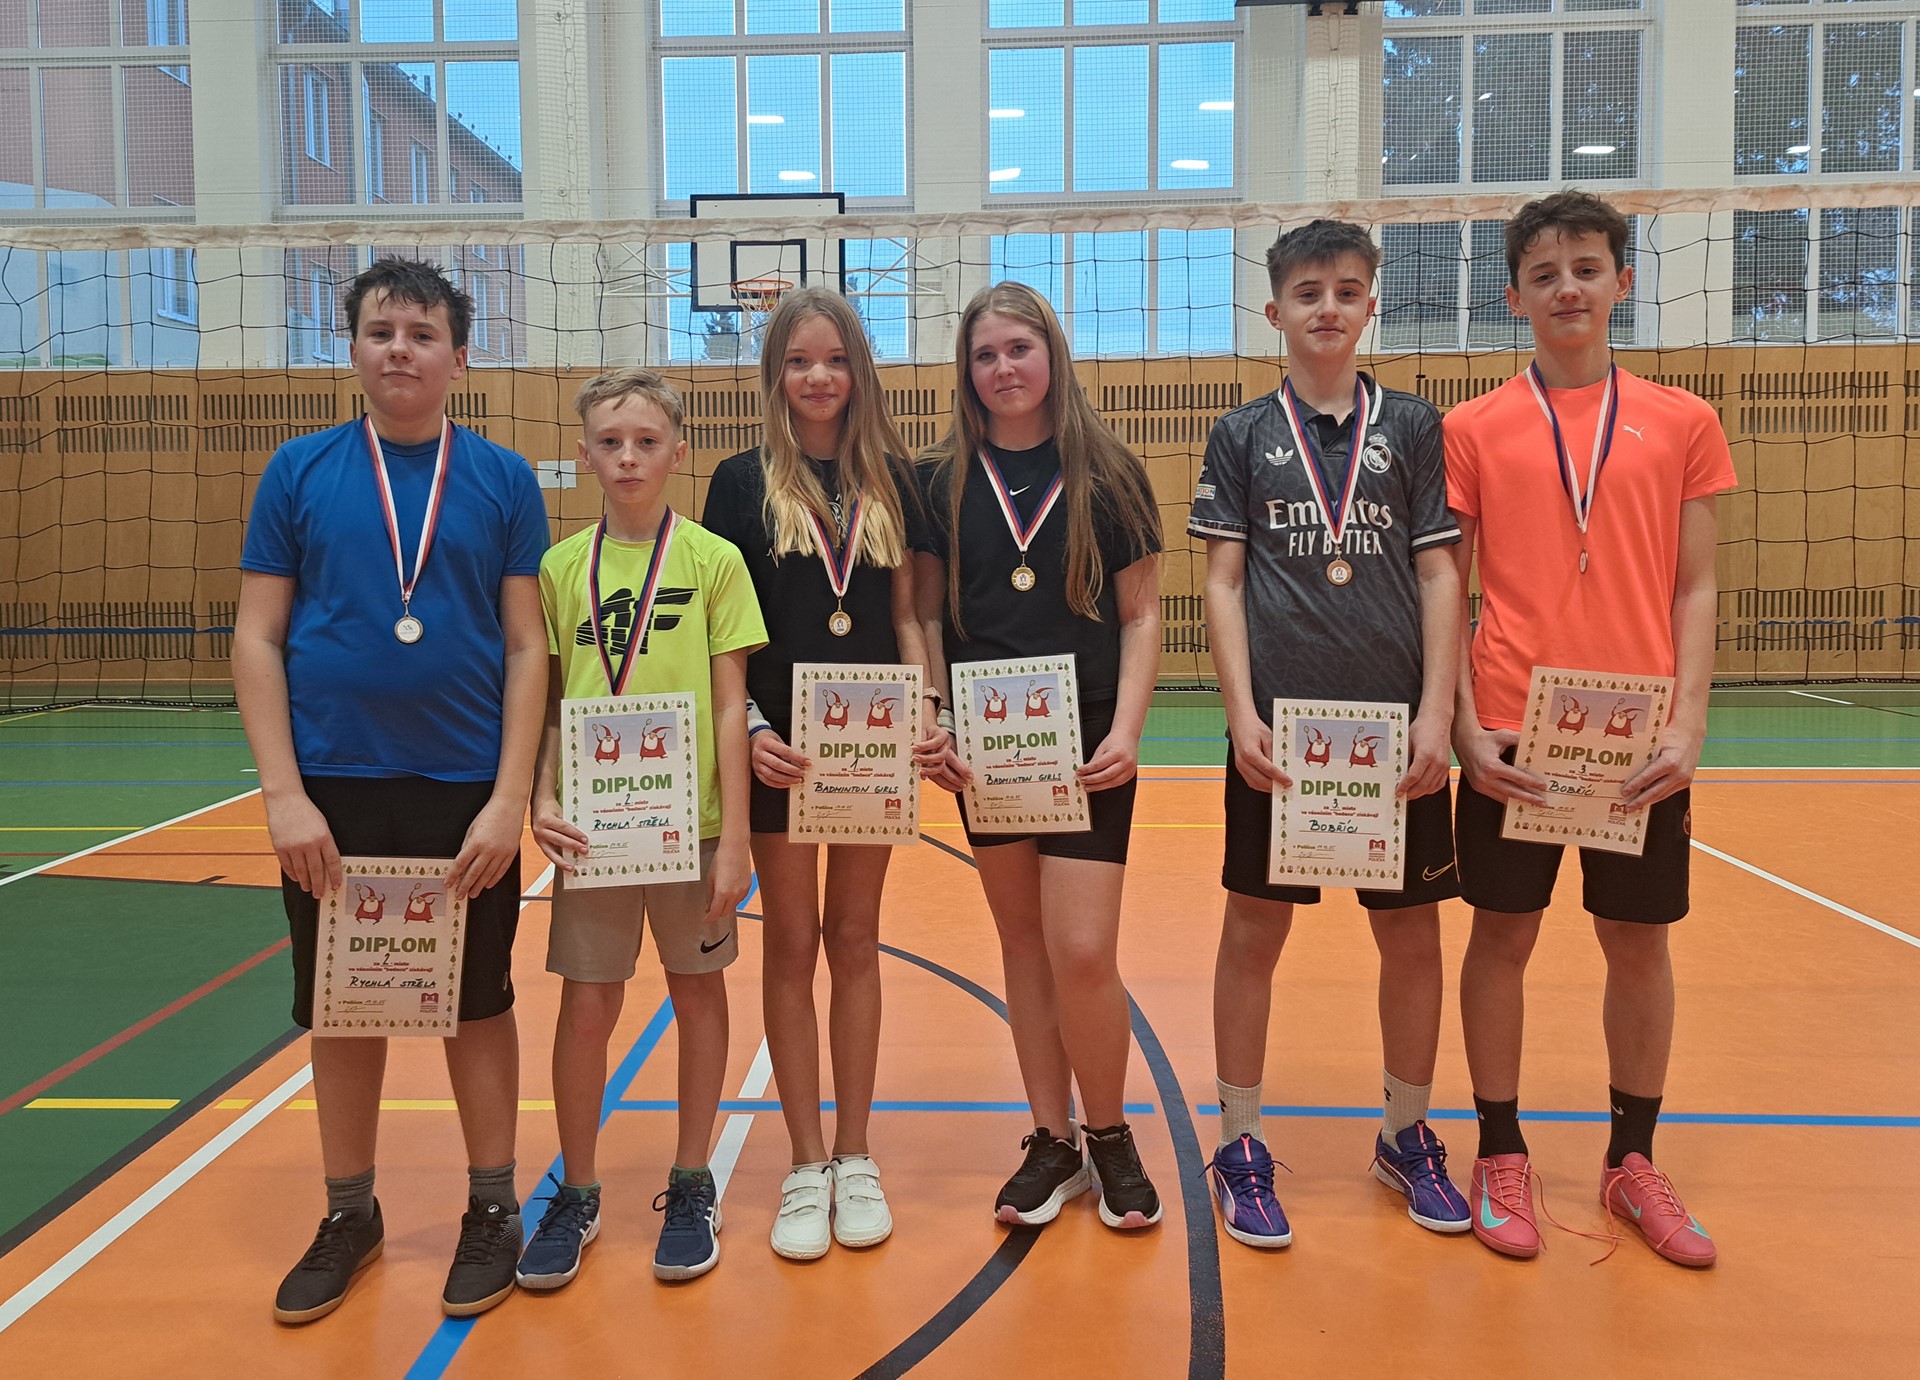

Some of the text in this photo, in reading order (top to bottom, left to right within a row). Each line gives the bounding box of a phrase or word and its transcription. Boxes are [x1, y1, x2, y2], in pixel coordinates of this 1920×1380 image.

[1288, 531, 1317, 557] FLY
[983, 731, 1057, 750] DIPLOM
[820, 743, 896, 758] DIPLOM
[1547, 744, 1633, 766] DIPLOM
[592, 774, 672, 794] DIPLOM
[984, 773, 1061, 785] BADMINTON GIRLS
[813, 782, 899, 794] BADMINTON GIRLS
[1301, 780, 1380, 798] DIPLOM
[594, 816, 635, 830] RYCHLÁ
[350, 937, 436, 953] DIPLOM
[349, 976, 395, 988] RYCHLÁ
